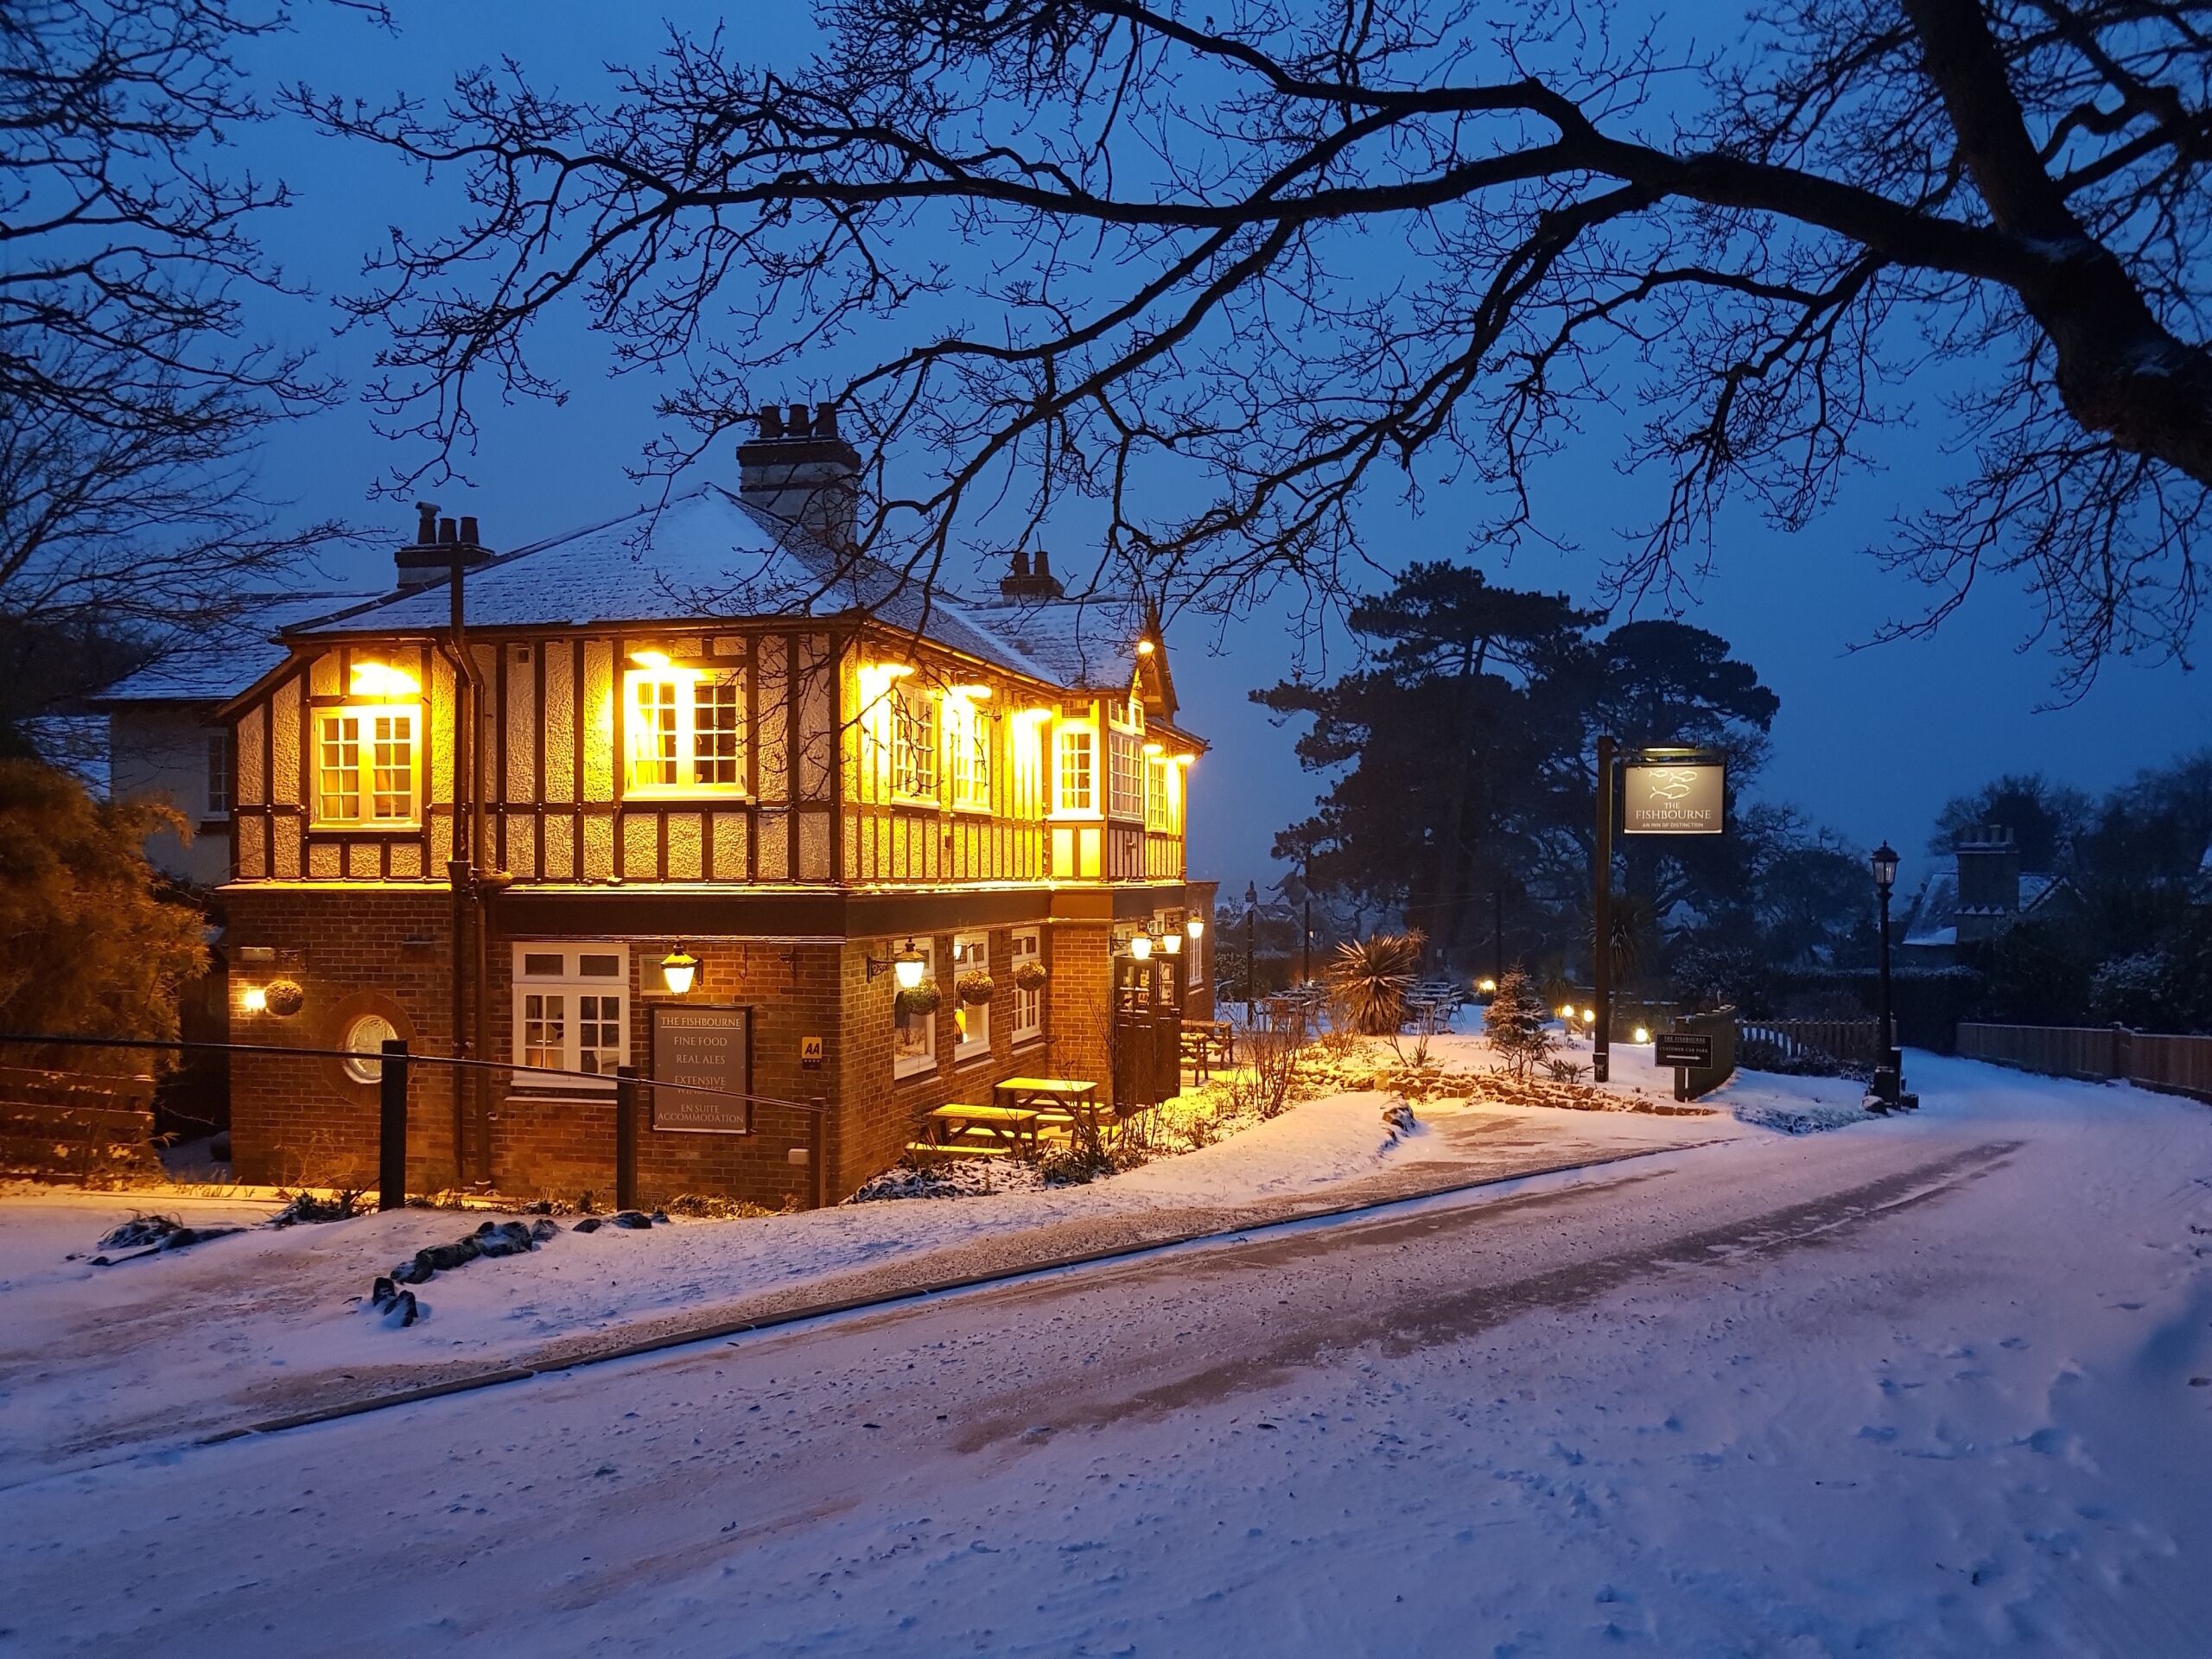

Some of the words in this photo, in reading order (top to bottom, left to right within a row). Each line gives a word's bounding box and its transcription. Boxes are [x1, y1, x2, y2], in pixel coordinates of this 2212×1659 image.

[1636, 810, 1711, 820] FISHBOURNE
[661, 1017, 679, 1026] THE
[682, 1017, 741, 1027] FISHBOURNE
[674, 1037, 696, 1046] FINE
[699, 1037, 727, 1046] FOOD
[805, 1043, 819, 1054] AA
[677, 1055, 700, 1064] REAL
[702, 1055, 726, 1065] ALES
[675, 1075, 726, 1085] EXTENSIVE
[658, 1113, 743, 1122] ACCOMMODATION
